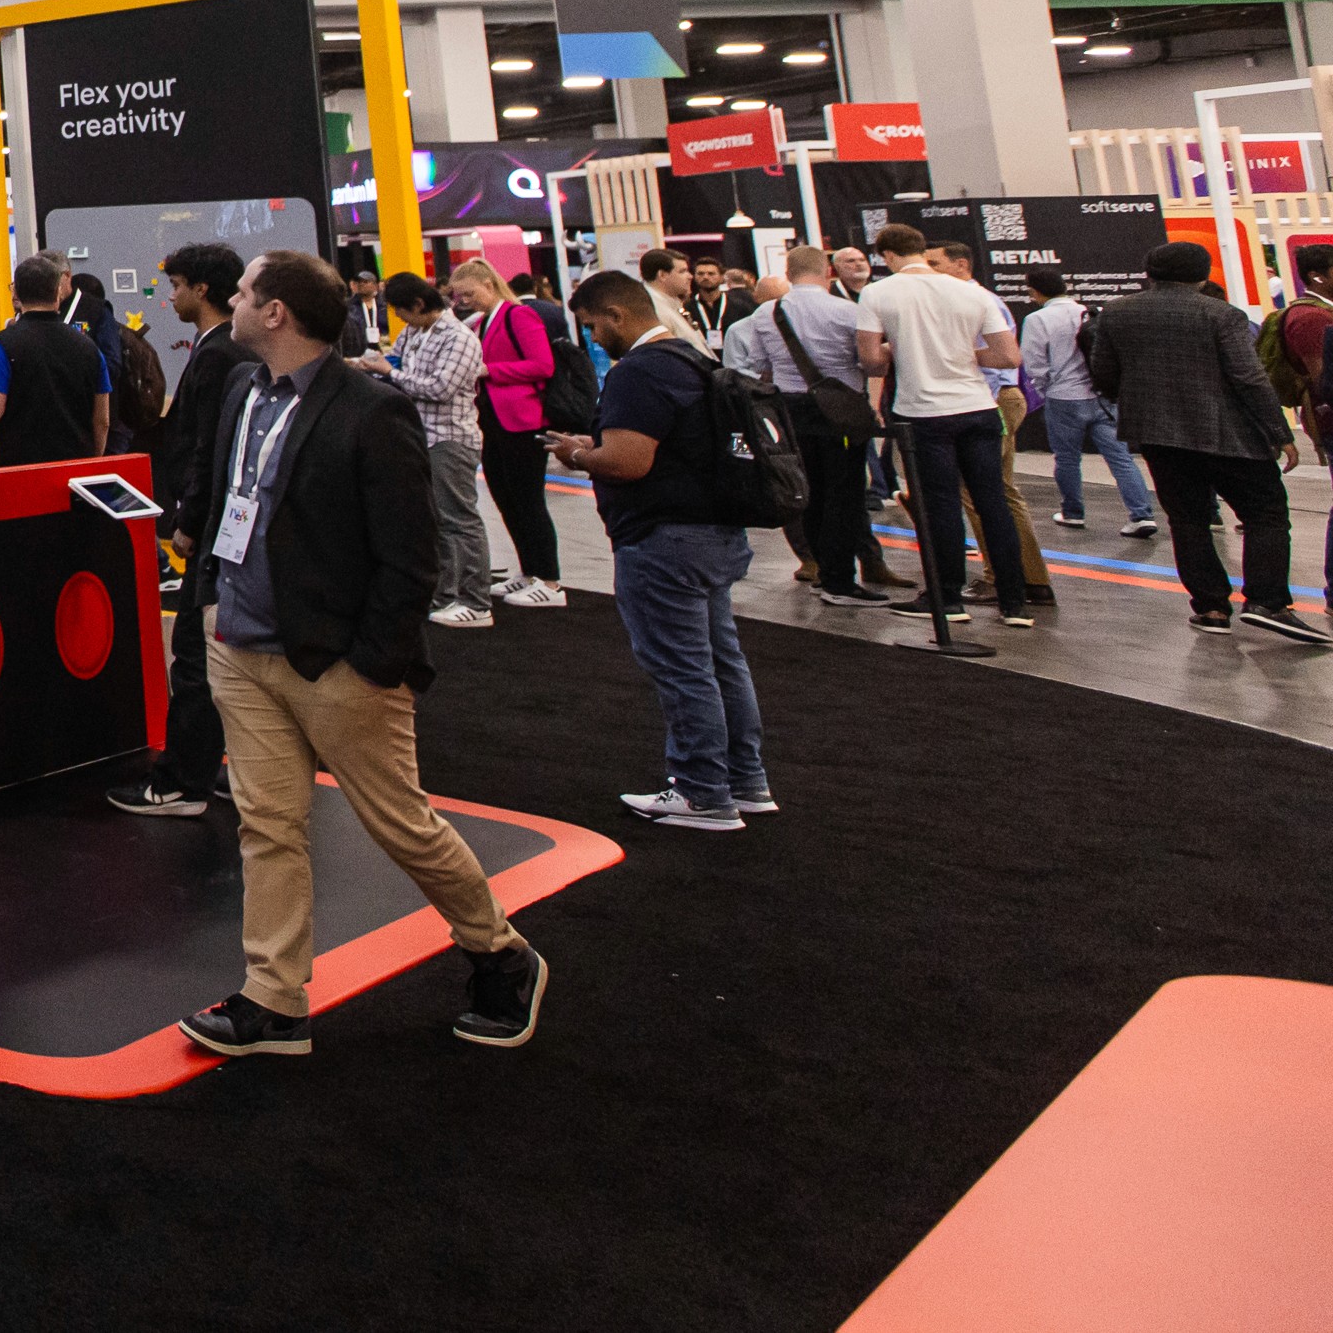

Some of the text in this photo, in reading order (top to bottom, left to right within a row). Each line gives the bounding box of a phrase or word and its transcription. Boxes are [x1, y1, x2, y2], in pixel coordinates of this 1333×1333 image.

[59, 77, 177, 109] Flex your
[61, 107, 186, 140] creativity
[686, 132, 755, 154] CROWDSTRIKE
[1080, 201, 1155, 214] softserve
[990, 249, 1062, 265] RETAIL
